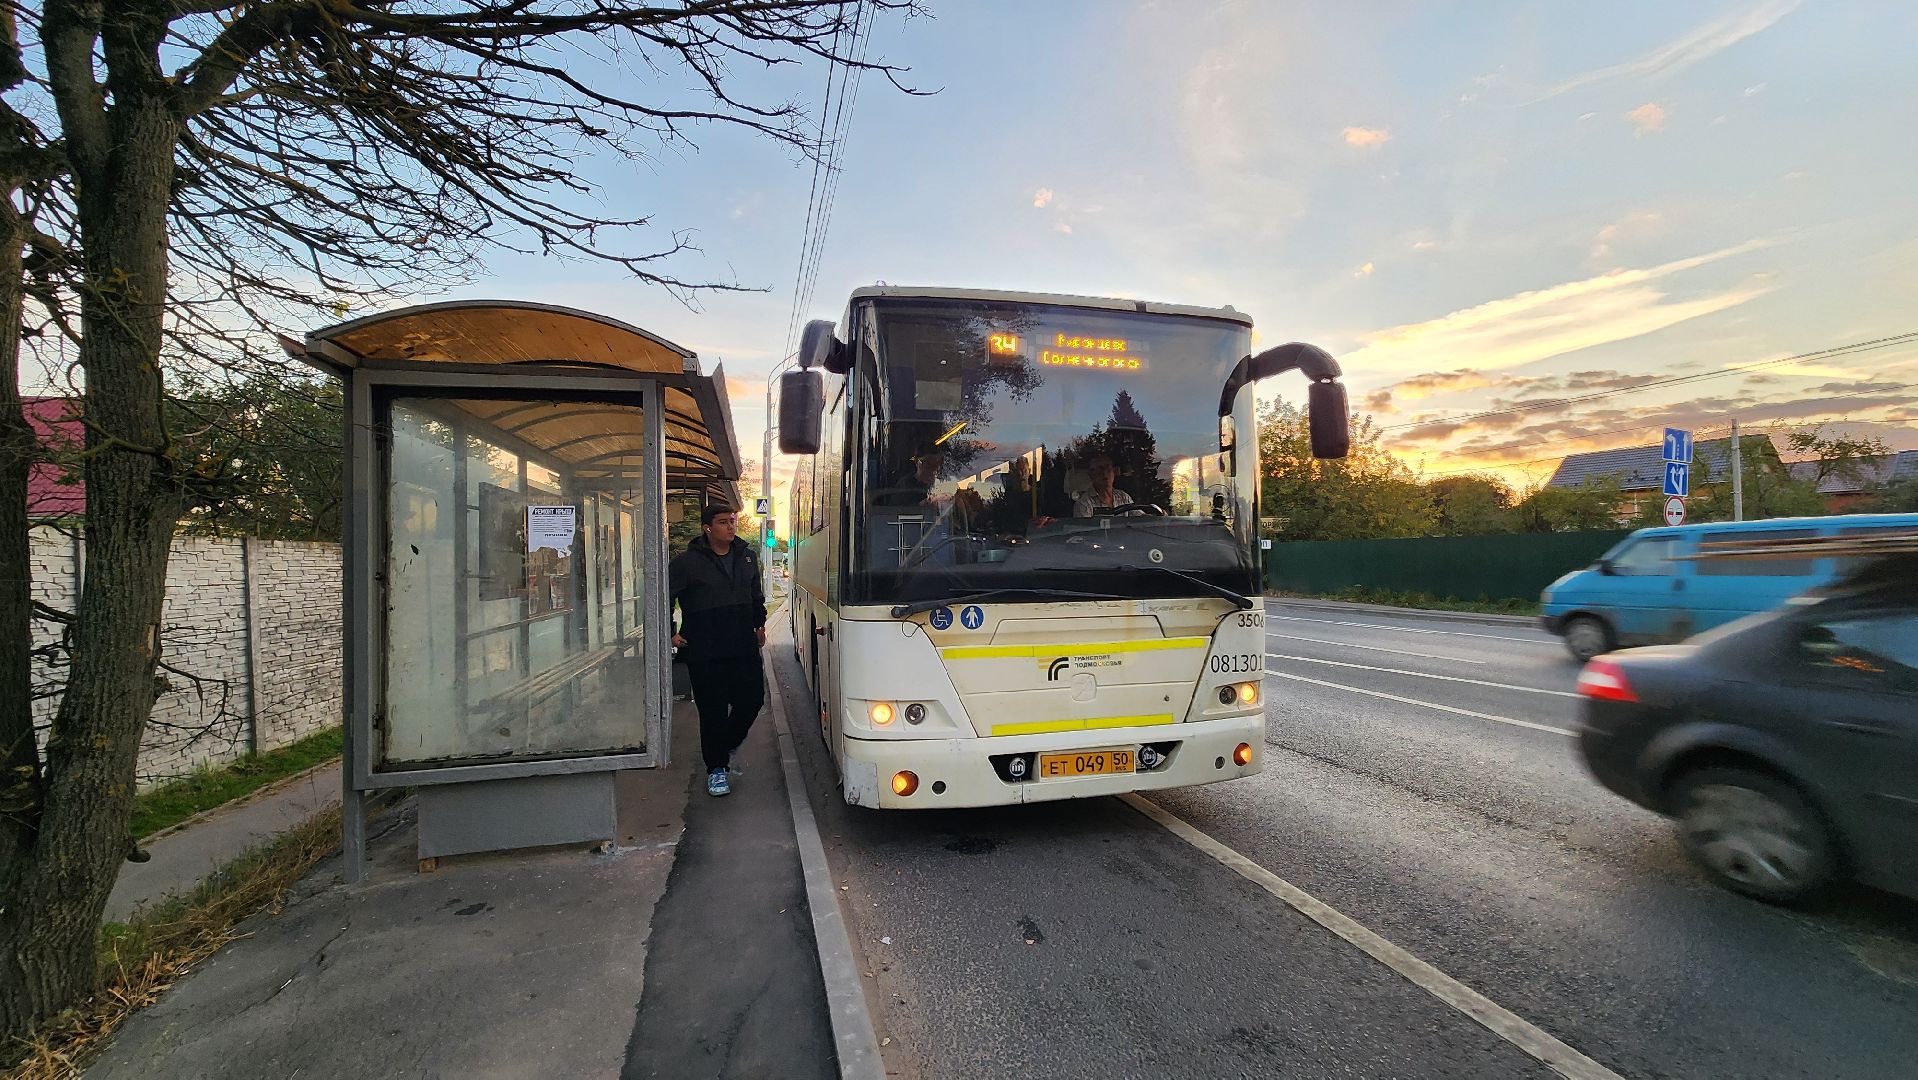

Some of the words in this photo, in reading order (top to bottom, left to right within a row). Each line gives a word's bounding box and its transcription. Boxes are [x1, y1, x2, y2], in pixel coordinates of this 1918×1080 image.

[1073, 654, 1111, 662] ТРАНСПОРТ
[1211, 654, 1262, 673] 081301
[1075, 756, 1104, 773] 049
[1113, 752, 1129, 766] 50
